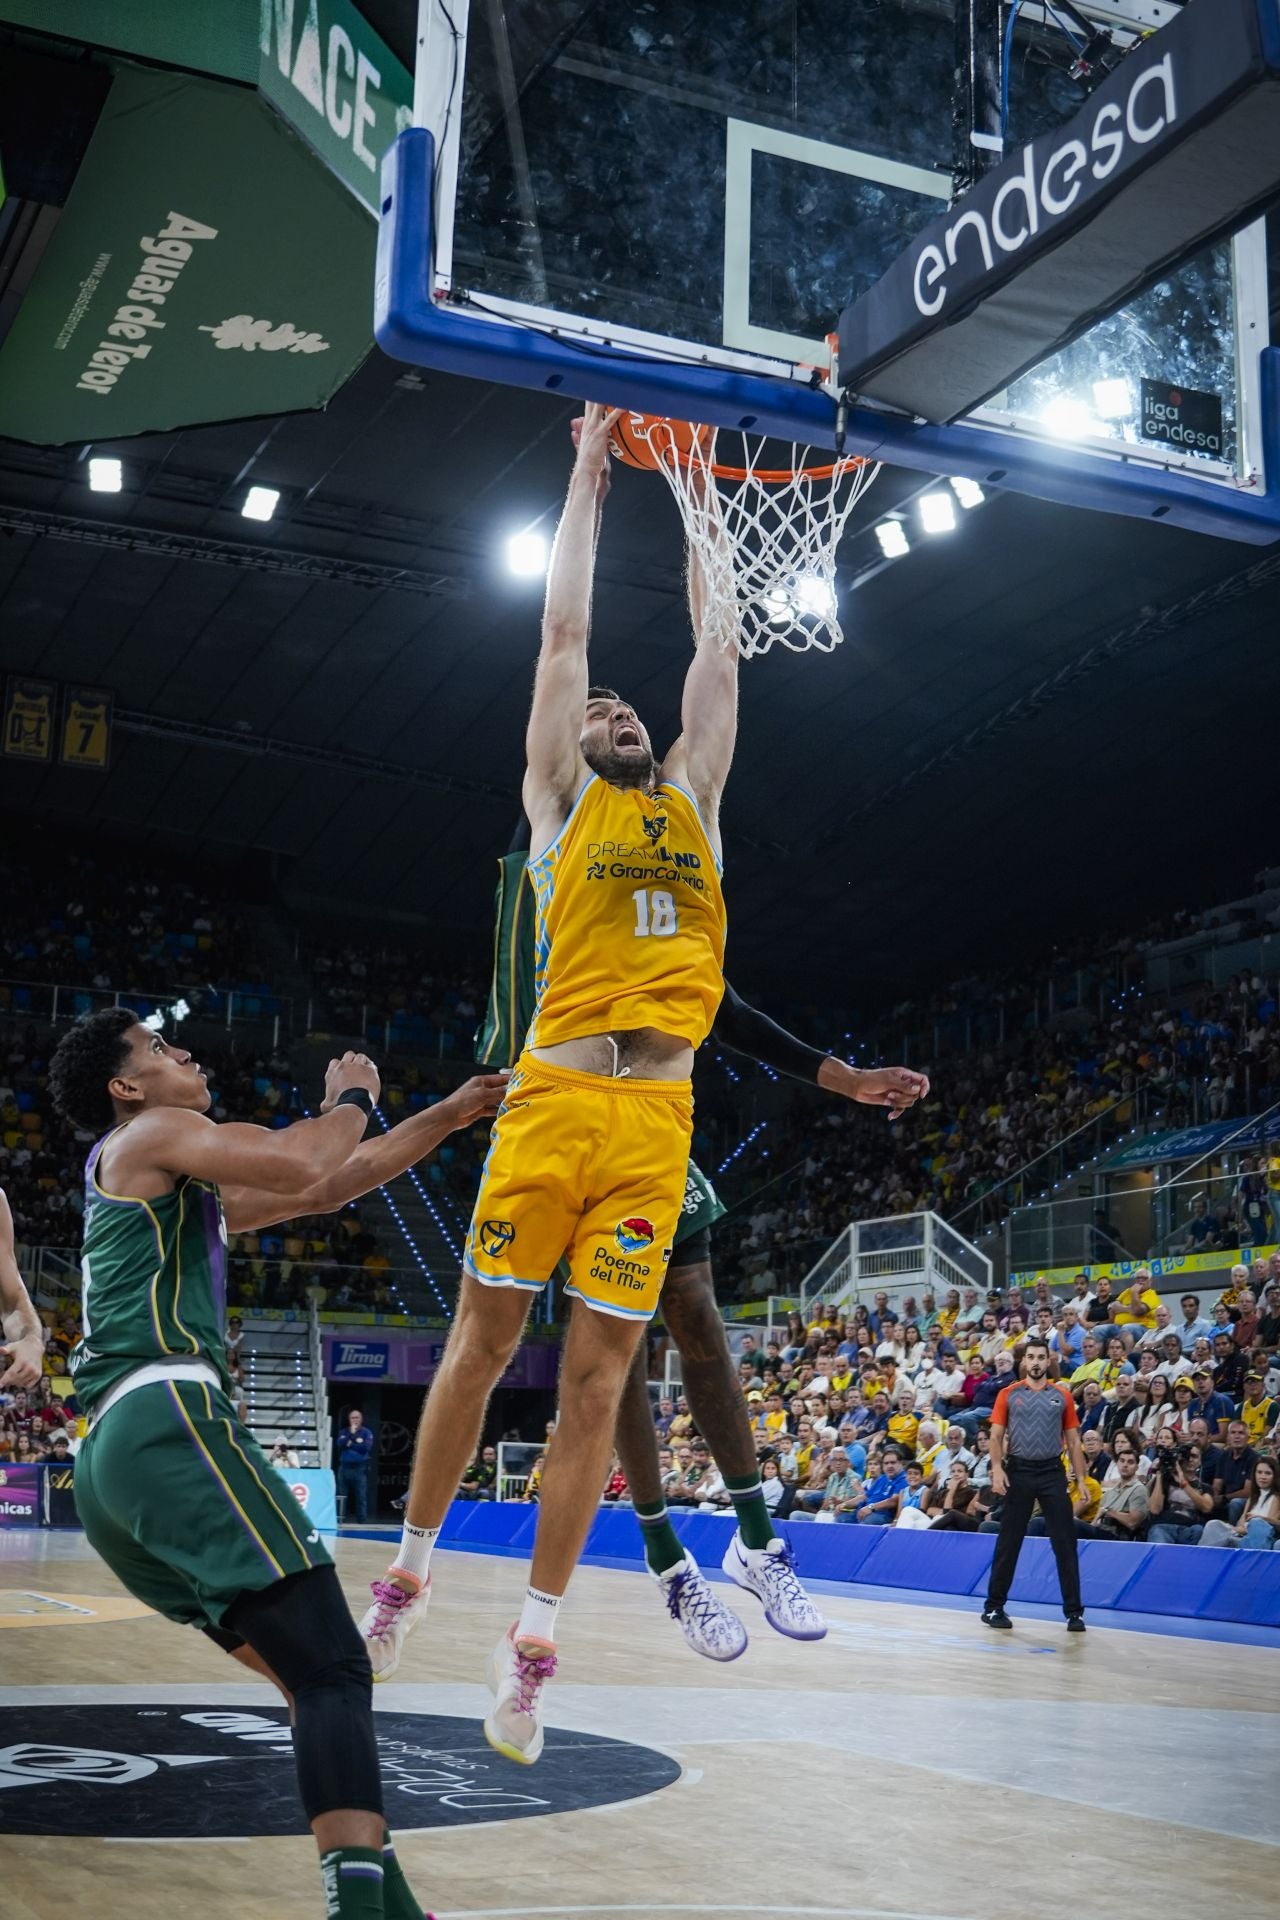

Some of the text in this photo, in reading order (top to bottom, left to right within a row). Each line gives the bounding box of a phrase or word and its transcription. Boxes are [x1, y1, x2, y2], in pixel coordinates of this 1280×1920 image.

[913, 52, 1177, 317] endesa
[53, 252, 113, 350] www.aguasdeteror.com
[75, 210, 219, 395] Aguas de Teror
[1144, 396, 1179, 421] liga
[1145, 420, 1220, 450] endesa
[587, 841, 702, 869] DREAMLND
[632, 889, 678, 937] 18
[594, 1247, 650, 1276] Poema
[590, 1265, 646, 1291] del Mar
[339, 1343, 386, 1366] Tirma
